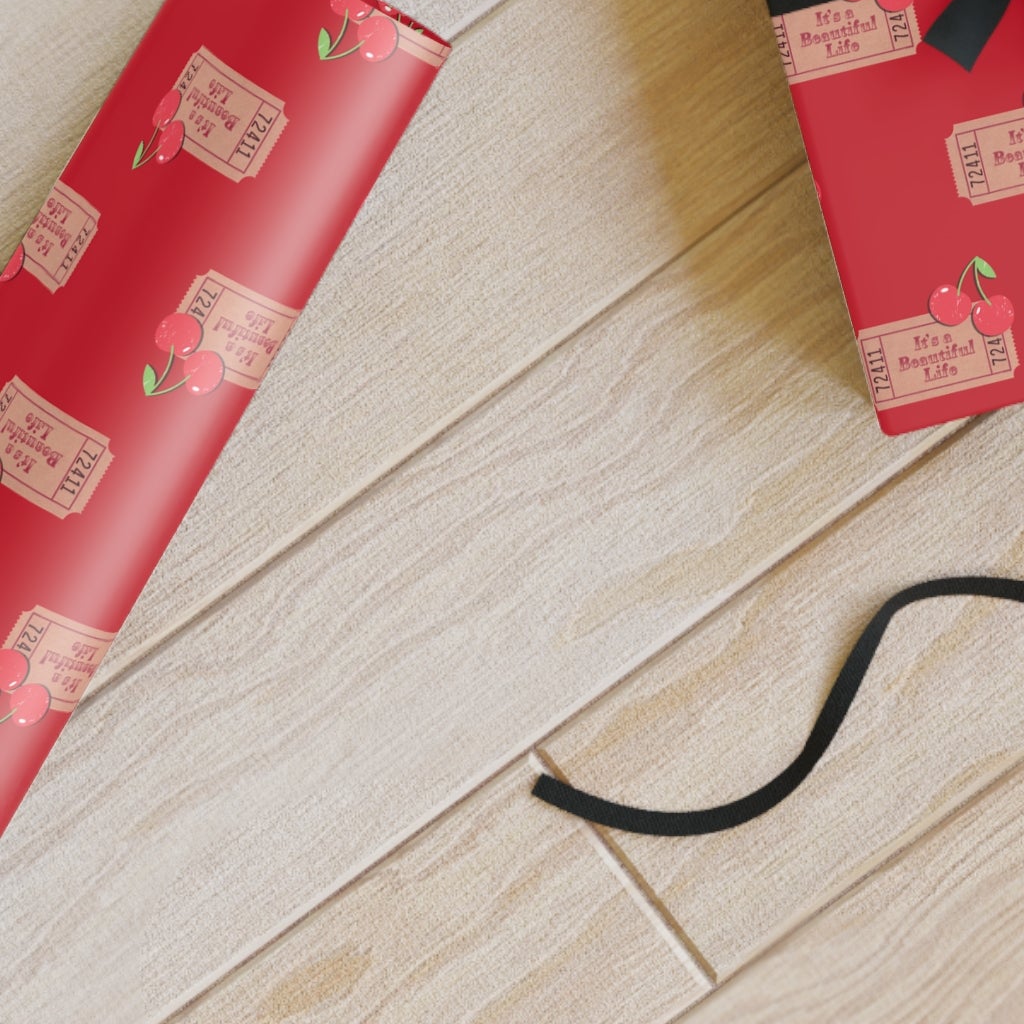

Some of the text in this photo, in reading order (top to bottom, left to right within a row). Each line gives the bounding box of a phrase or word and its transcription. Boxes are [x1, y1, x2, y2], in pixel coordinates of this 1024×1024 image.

[799, 15, 878, 48] Beautiful
[815, 9, 855, 27] It's a
[889, 13, 909, 43] 724
[825, 39, 860, 59] Life
[209, 79, 233, 105] Life
[186, 87, 240, 132] Beautiful
[188, 110, 216, 138] It's a
[236, 113, 273, 159] 72411
[962, 142, 985, 188] 72411
[47, 198, 72, 224] Life
[26, 228, 54, 256] It's a
[61, 228, 90, 270] 72411
[190, 288, 218, 317] 724
[212, 316, 278, 354] Beautiful
[245, 310, 275, 335] Life
[225, 341, 259, 367] It's a
[898, 339, 976, 372] Beautiful
[913, 333, 952, 351] It's a
[987, 337, 1007, 366] 724
[867, 348, 891, 394] 72411
[923, 363, 958, 382] Life
[25, 412, 54, 440] Life
[0, 419, 64, 468] Beautiful
[5, 443, 37, 474] It's a
[60, 449, 98, 496] 72411
[16, 623, 44, 652] 724
[71, 641, 99, 661] Life
[51, 673, 82, 694] It's a
